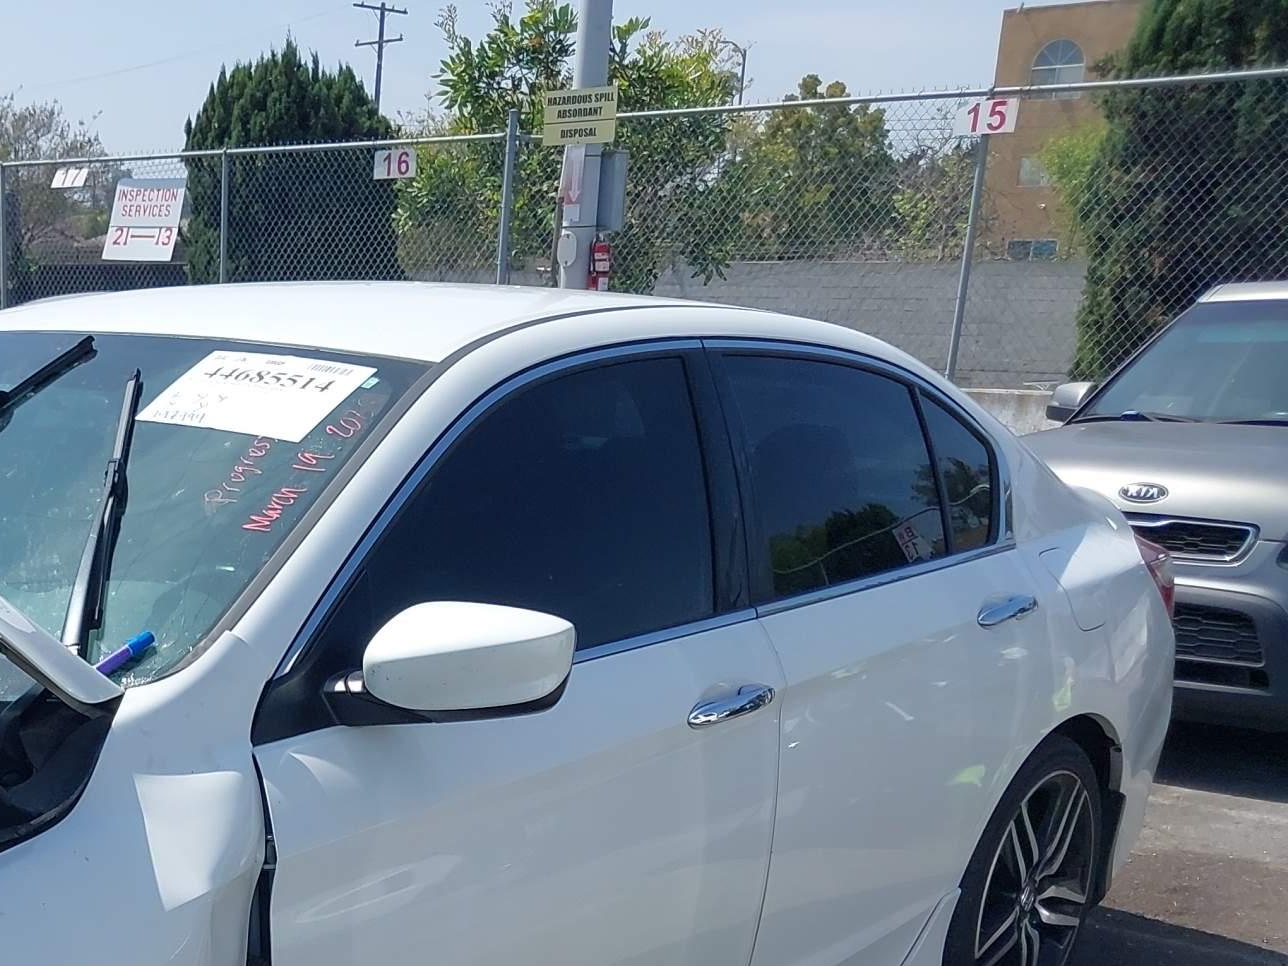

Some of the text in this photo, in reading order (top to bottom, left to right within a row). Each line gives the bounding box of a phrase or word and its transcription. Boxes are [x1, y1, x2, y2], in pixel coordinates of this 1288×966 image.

[547, 92, 615, 106] HAZARDOUS SPILL
[967, 100, 1008, 132] 15
[560, 127, 597, 139] DISPOSAL
[383, 151, 410, 177] 16
[118, 188, 179, 203] INSPECTION
[121, 204, 172, 218] SERVICES
[203, 366, 337, 393] 44685514
[204, 435, 273, 505] Progres
[242, 486, 309, 533] March
